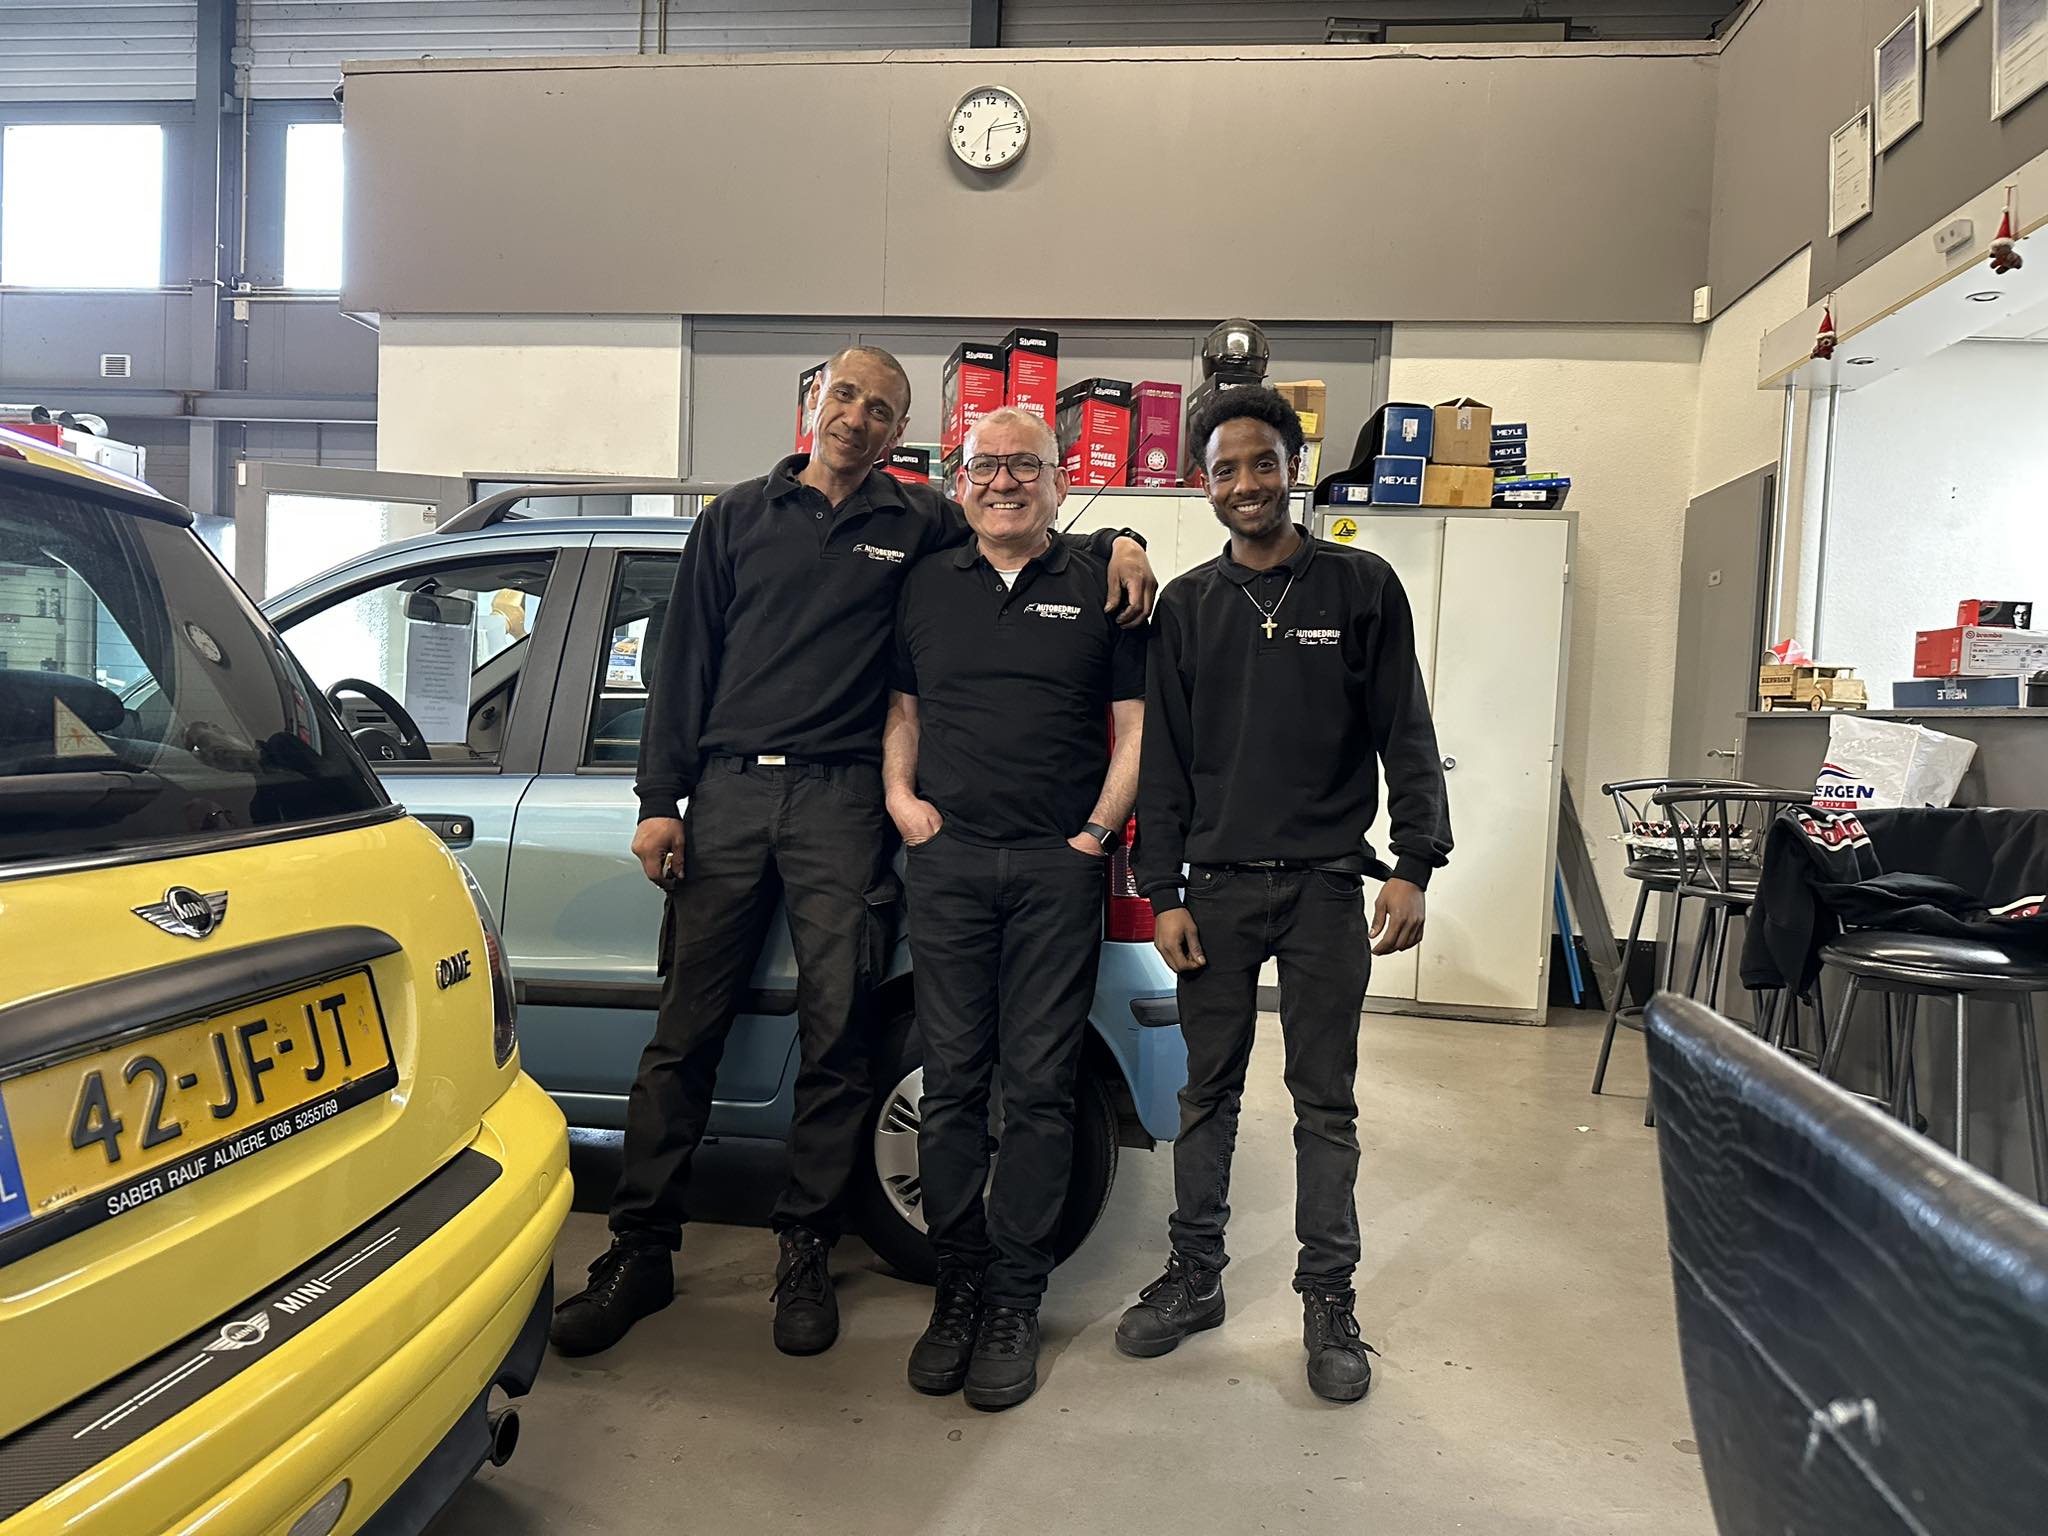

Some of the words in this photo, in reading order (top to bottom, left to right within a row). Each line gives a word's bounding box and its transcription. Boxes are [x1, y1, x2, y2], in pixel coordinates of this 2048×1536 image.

[985, 96, 997, 105] 12
[958, 125, 965, 133] 9
[1015, 125, 1021, 133] 3
[984, 153, 991, 162] 6
[1017, 402, 1045, 412] WHEEL
[1496, 428, 1523, 436] MEYLE
[1090, 451, 1117, 461] WHEEL
[1494, 447, 1522, 456] MEYLE
[1090, 459, 1116, 468] COVERS
[1378, 476, 1418, 485] MEYLE
[178, 901, 210, 920] MINI
[436, 949, 472, 991] ONE
[70, 993, 351, 1163] 42-JF-JT
[106, 1177, 164, 1216] SABER
[167, 1156, 208, 1189] RAUF
[213, 1130, 267, 1169] ALMERE
[269, 1120, 292, 1141] 036
[295, 1098, 338, 1130] 5255769
[273, 1278, 333, 1315] MINI
[230, 1325, 257, 1341] MINI
